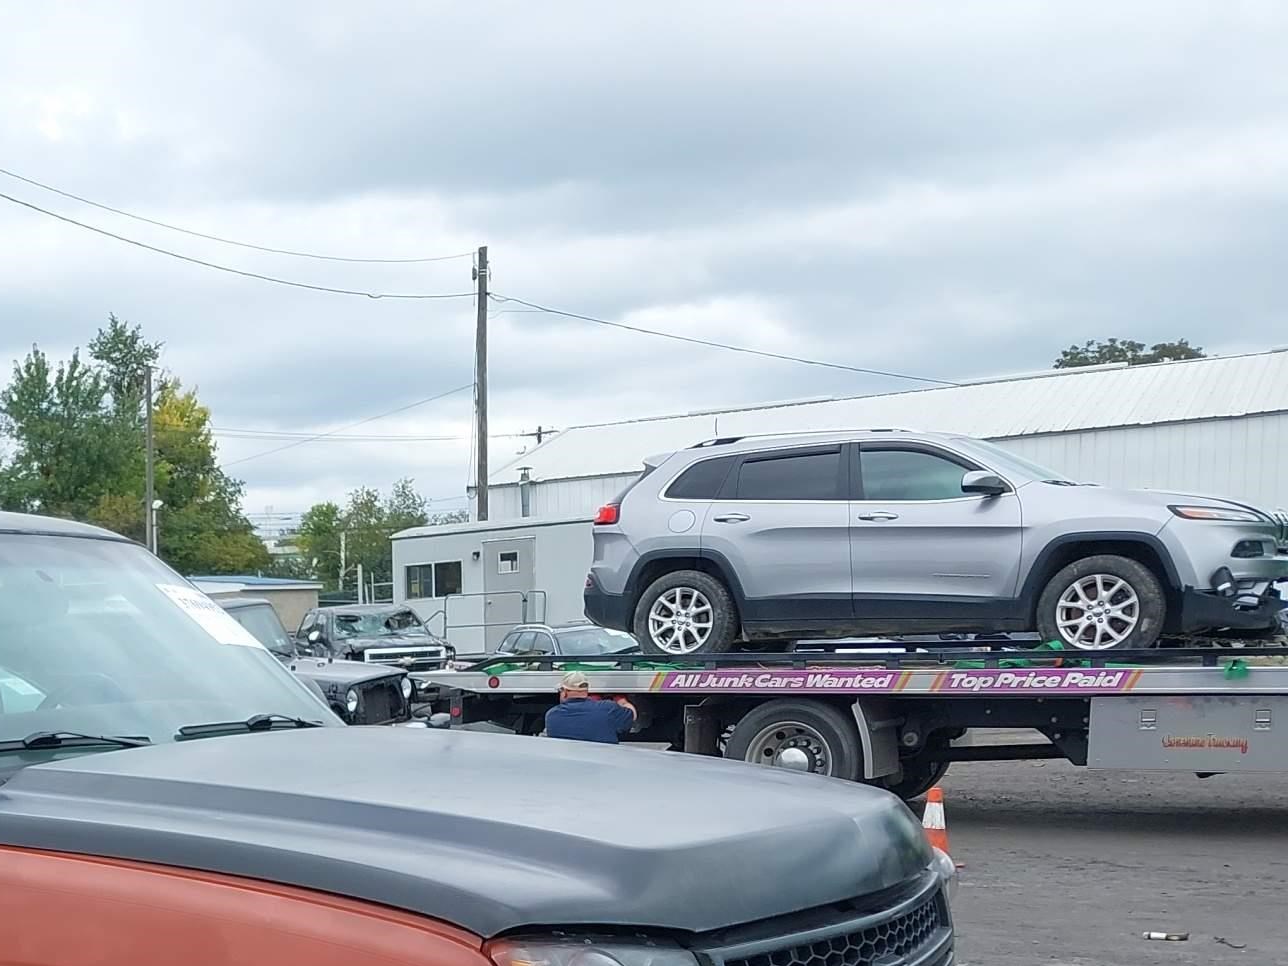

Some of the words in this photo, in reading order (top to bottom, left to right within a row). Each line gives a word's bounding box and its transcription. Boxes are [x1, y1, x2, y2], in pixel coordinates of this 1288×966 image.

[670, 674, 697, 688] All
[697, 674, 755, 688] Junk
[755, 674, 804, 688] Cars
[806, 674, 893, 688] Wanted
[950, 672, 993, 691] Top
[995, 672, 1061, 688] Price
[1062, 672, 1123, 688] Paid
